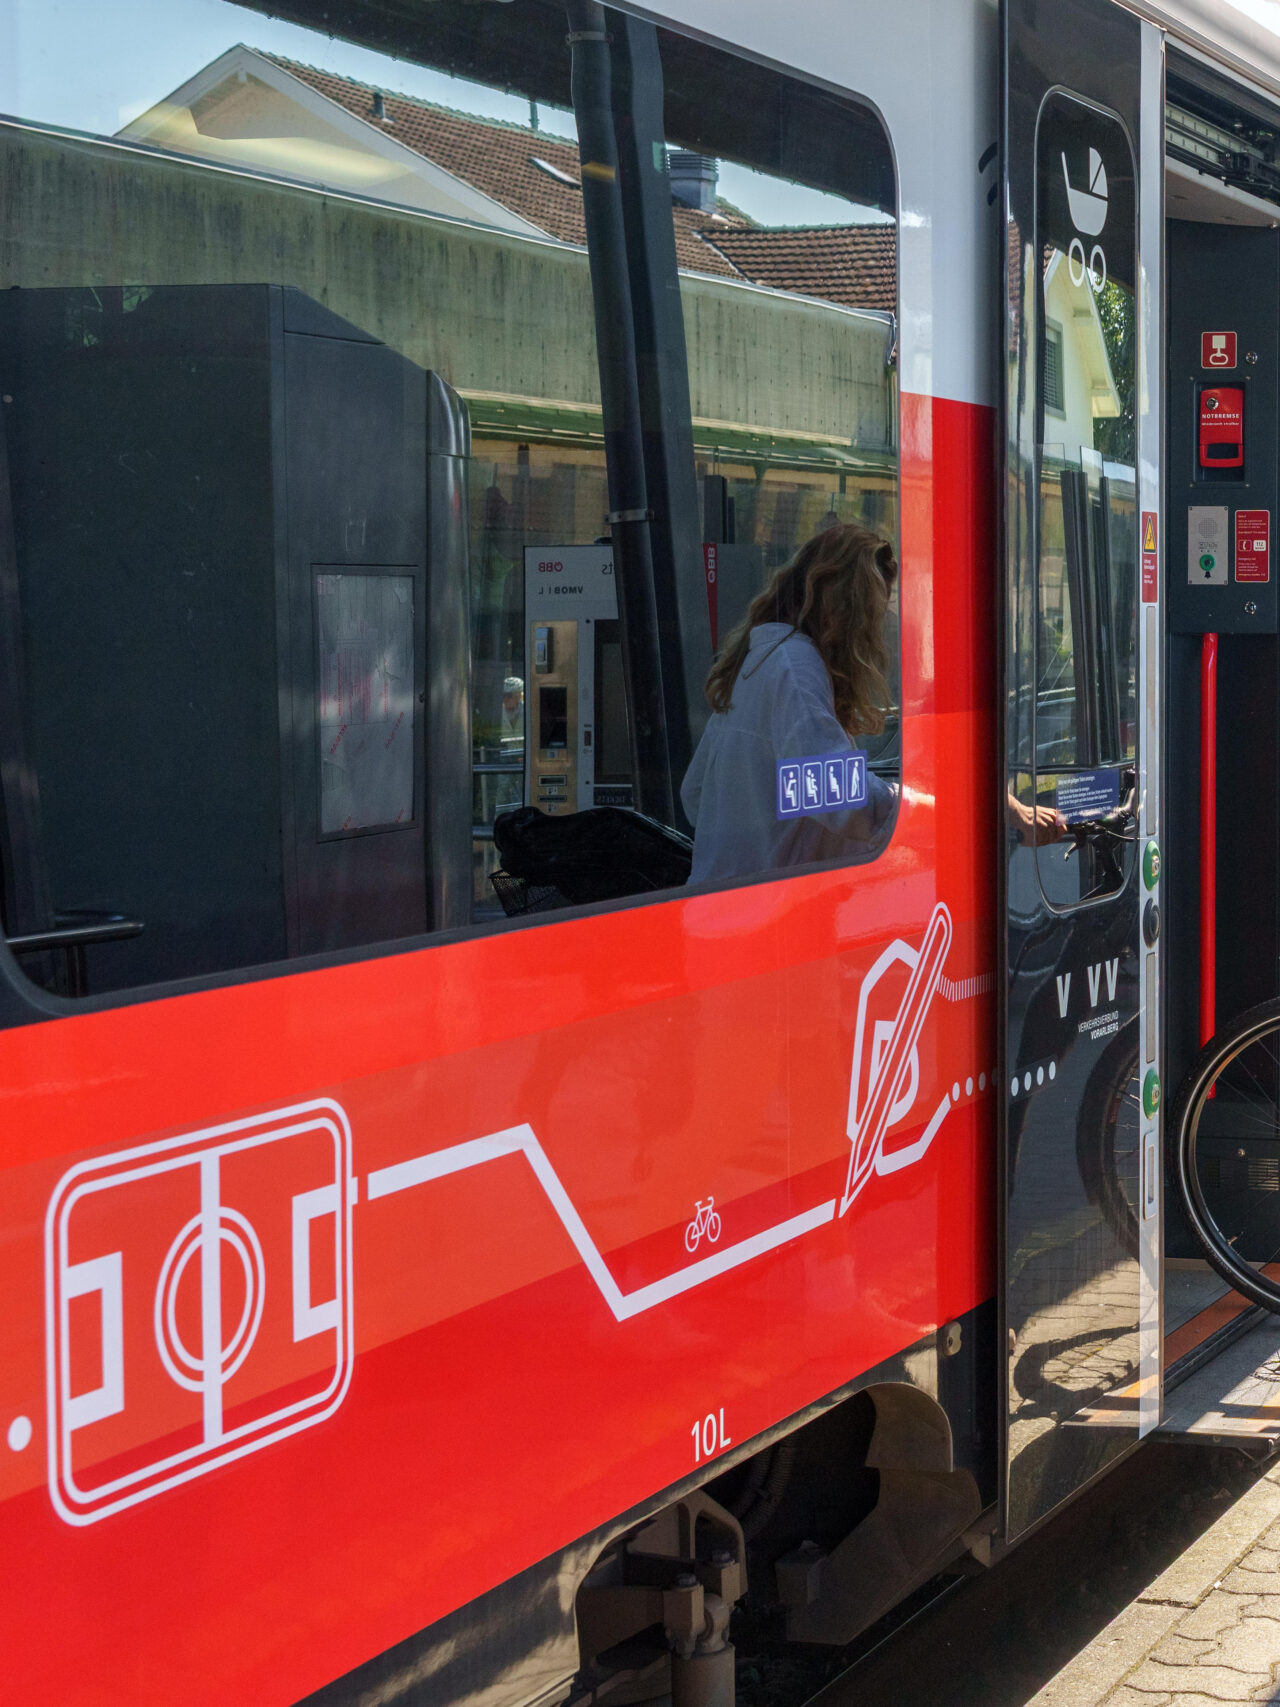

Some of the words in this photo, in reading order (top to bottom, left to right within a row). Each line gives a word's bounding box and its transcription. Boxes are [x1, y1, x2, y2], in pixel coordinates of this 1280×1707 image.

[1078, 1010, 1119, 1033] VERKEHRSVERBUND
[1090, 1022, 1119, 1040] VORARLBERG
[691, 1407, 732, 1462] 10L
